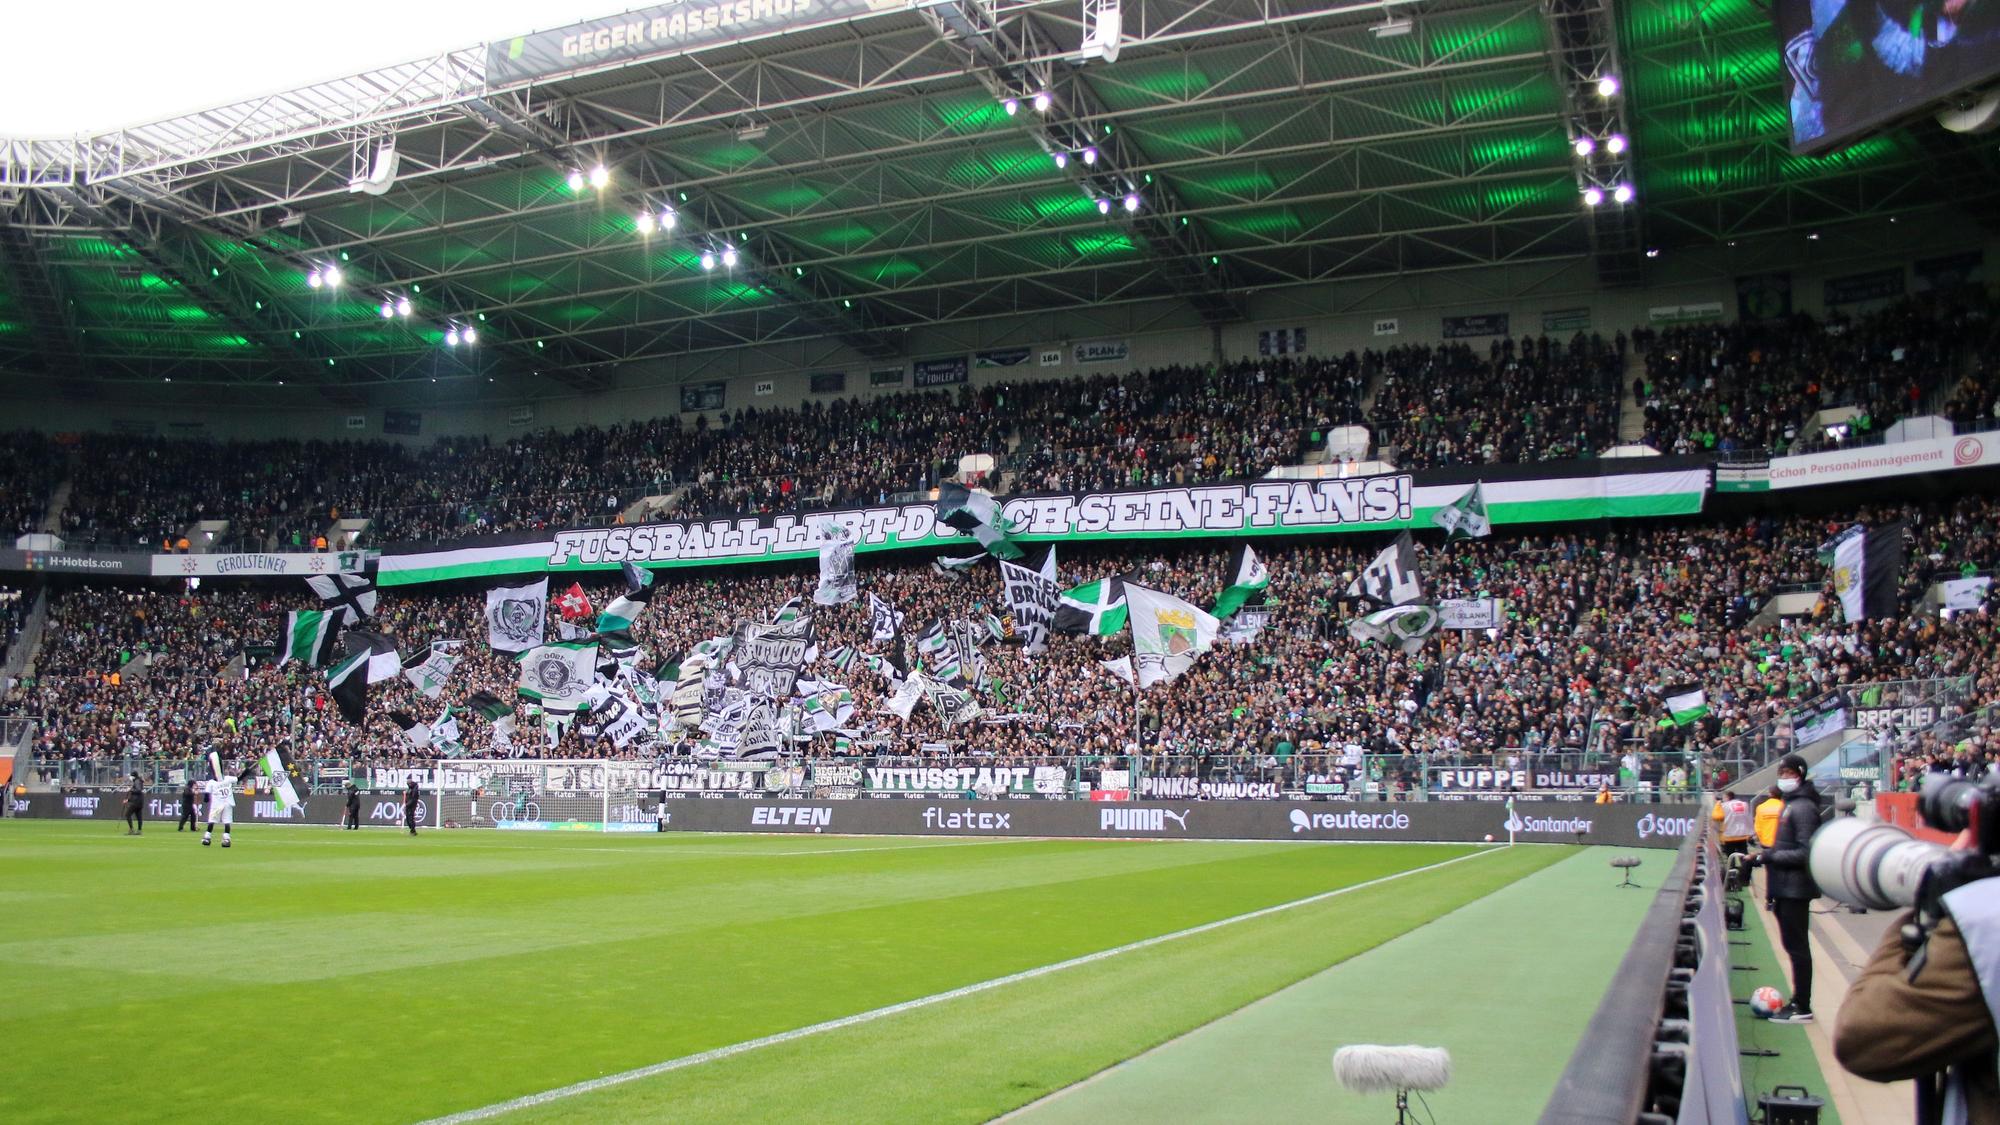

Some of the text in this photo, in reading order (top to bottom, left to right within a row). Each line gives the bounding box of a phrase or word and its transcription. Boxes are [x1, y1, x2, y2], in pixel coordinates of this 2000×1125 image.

[562, 0, 811, 57] GEGEN RASSISMUS
[1376, 323, 1396, 332] 15A
[1042, 354, 1059, 363] 16A
[1088, 346, 1115, 356] PLAN
[757, 383, 772, 392] 17A
[1769, 448, 1944, 480] Cichon Personalmanagement
[547, 517, 767, 566] FUSSBALL
[1076, 484, 1246, 533] SEINE
[1249, 474, 1414, 527] FANS!
[49, 555, 124, 570] H-Hotels.com
[216, 553, 288, 574] GEROLSTEINER
[814, 766, 854, 777] BEGLEIT
[866, 767, 1031, 790] VITUSSTADT
[1441, 770, 1526, 788] FUPPE
[1536, 770, 1616, 788] DÜLKEN
[814, 776, 854, 786] SERVICE
[1142, 776, 1200, 796] PINKIS
[65, 797, 100, 809] UNIBET
[699, 791, 725, 799] flatex
[737, 791, 764, 799] flatex
[869, 792, 891, 800] flatex
[903, 792, 925, 800] flatex
[937, 792, 960, 800] flatex
[1008, 792, 1031, 800] flatex
[370, 802, 405, 819] AOK
[751, 806, 833, 825] ELTEN
[921, 806, 1011, 829] flatex
[1100, 808, 1165, 830] PUMA
[1312, 809, 1409, 830] reuter.de
[1524, 815, 1593, 834] Santander
